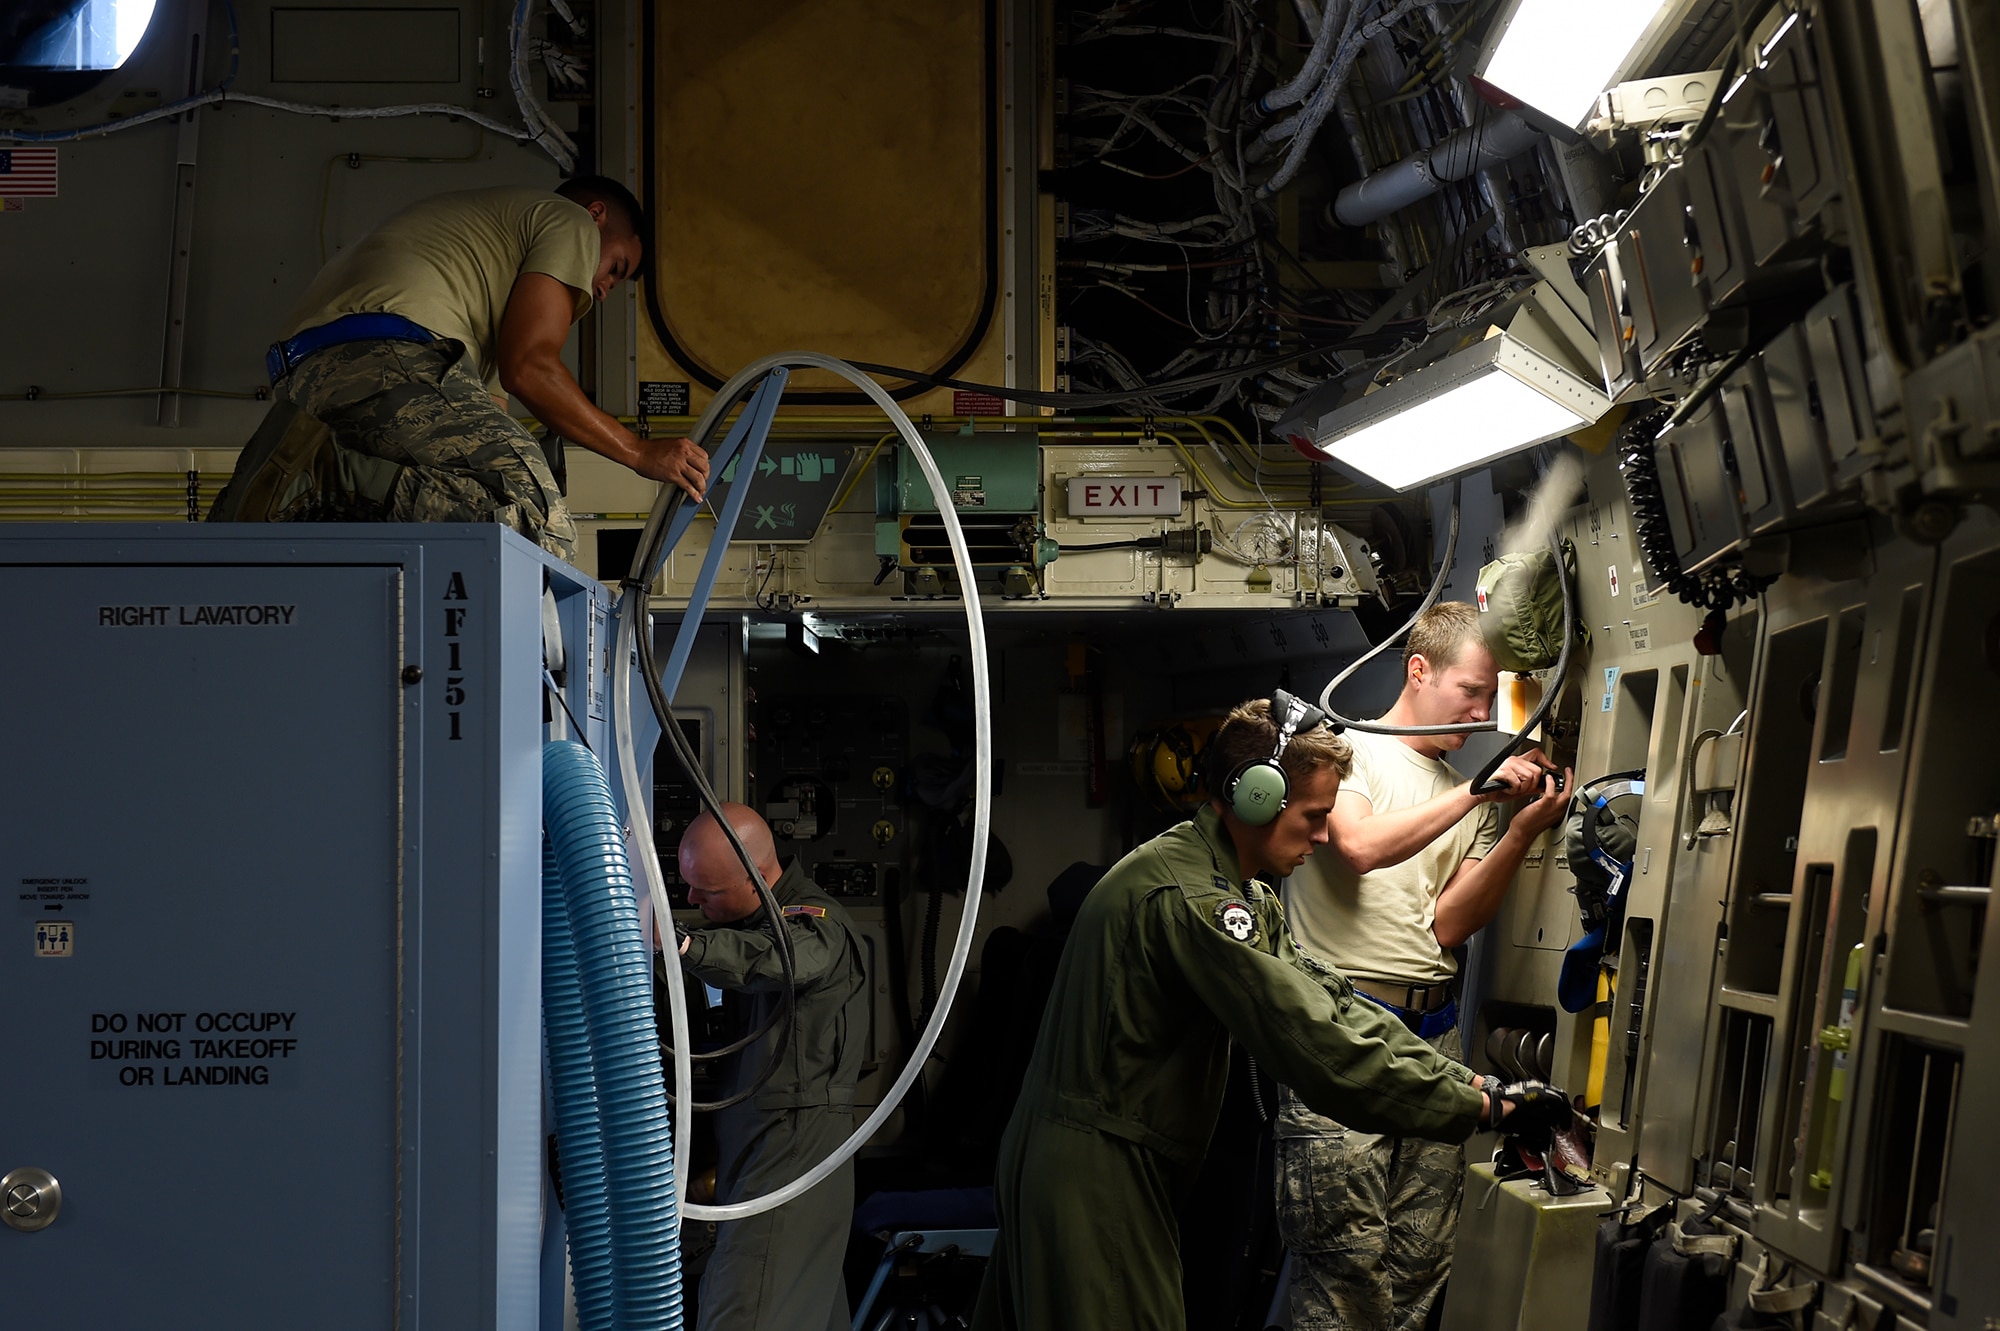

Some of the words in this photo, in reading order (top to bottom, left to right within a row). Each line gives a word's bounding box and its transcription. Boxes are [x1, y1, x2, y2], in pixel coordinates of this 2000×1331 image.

[1085, 485, 1165, 507] EXIT
[100, 606, 170, 626] RIGHT
[179, 605, 295, 626] LAVATORY
[91, 1013, 128, 1034] DO
[137, 1013, 187, 1033] NOT
[196, 1012, 297, 1033] OCCUPY
[90, 1039, 181, 1060] DURING
[189, 1038, 298, 1060] TAKEOFF
[119, 1066, 154, 1087] OR
[163, 1065, 269, 1087] LANDING
